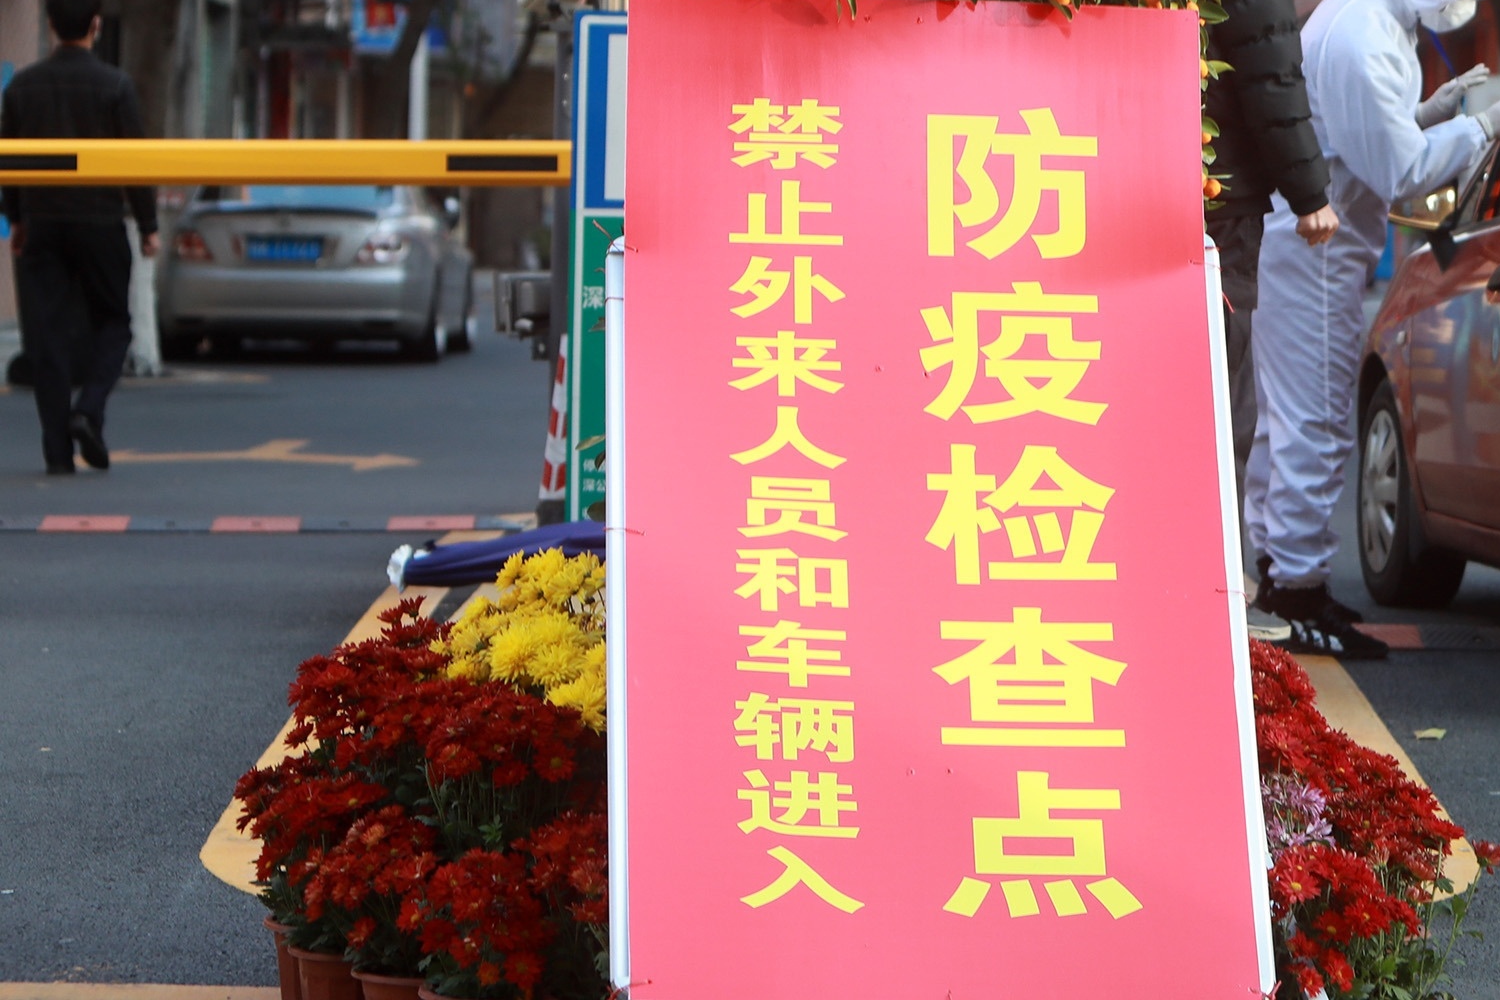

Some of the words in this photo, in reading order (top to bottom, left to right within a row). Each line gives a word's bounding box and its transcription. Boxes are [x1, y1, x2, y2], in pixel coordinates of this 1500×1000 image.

[728, 98, 865, 914] 禁止外来人员和车辆进入
[919, 107, 1144, 920] 防疫检查点
